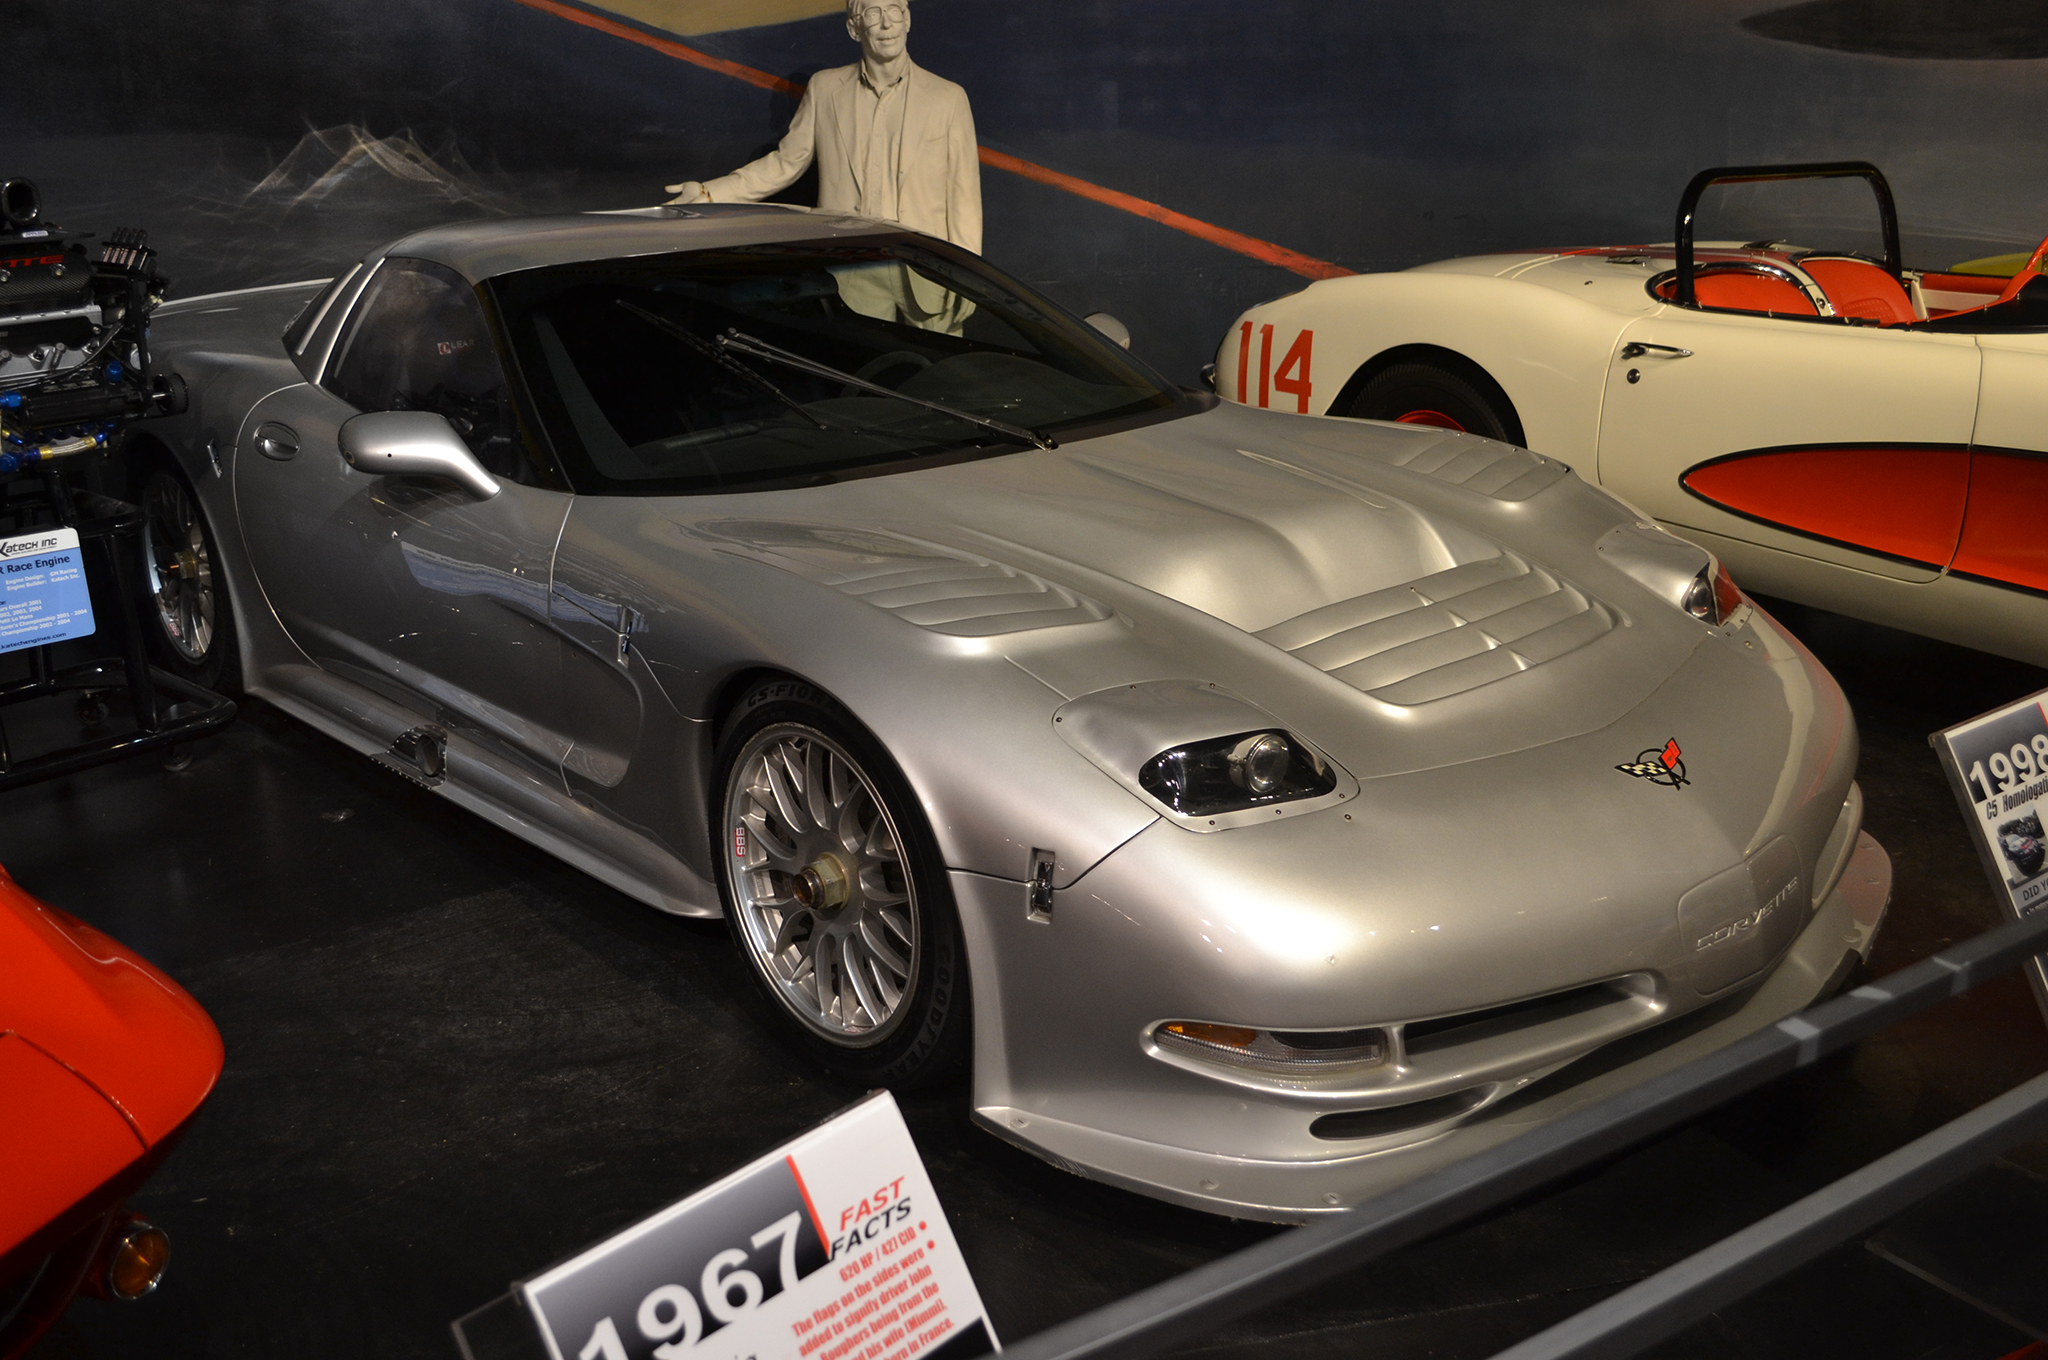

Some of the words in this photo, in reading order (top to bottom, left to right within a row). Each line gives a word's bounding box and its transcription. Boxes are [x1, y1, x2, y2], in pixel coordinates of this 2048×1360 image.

[1237, 320, 1313, 414] 114
[7, 562, 33, 573] Race
[35, 556, 70, 568] Engine
[1969, 734, 2048, 799] 1998
[1986, 799, 1998, 819] C5
[736, 827, 746, 857] BBS
[1696, 876, 1797, 952] CORVETTE
[2022, 884, 2040, 901] DID
[830, 1196, 911, 1261] FACTS
[840, 1175, 905, 1231] FAST
[839, 1260, 861, 1282] 620
[860, 1252, 874, 1270] HP
[897, 1226, 917, 1245] CID
[578, 1210, 802, 1360] 1967
[791, 1317, 814, 1337] The
[812, 1300, 841, 1324] flags
[840, 1291, 856, 1307] on
[854, 1280, 873, 1299] the
[872, 1262, 900, 1287] sides
[899, 1247, 925, 1270] were
[798, 1325, 833, 1357] added
[831, 1320, 845, 1336] to
[844, 1297, 880, 1328] signify
[879, 1278, 909, 1305] driver
[908, 1264, 933, 1288] John
[869, 1307, 900, 1334] being
[897, 1291, 924, 1315] from
[921, 1281, 940, 1300] the
[865, 1341, 884, 1360] his
[882, 1327, 905, 1348] wife
[883, 1347, 909, 1360] orn
[907, 1339, 920, 1354] in
